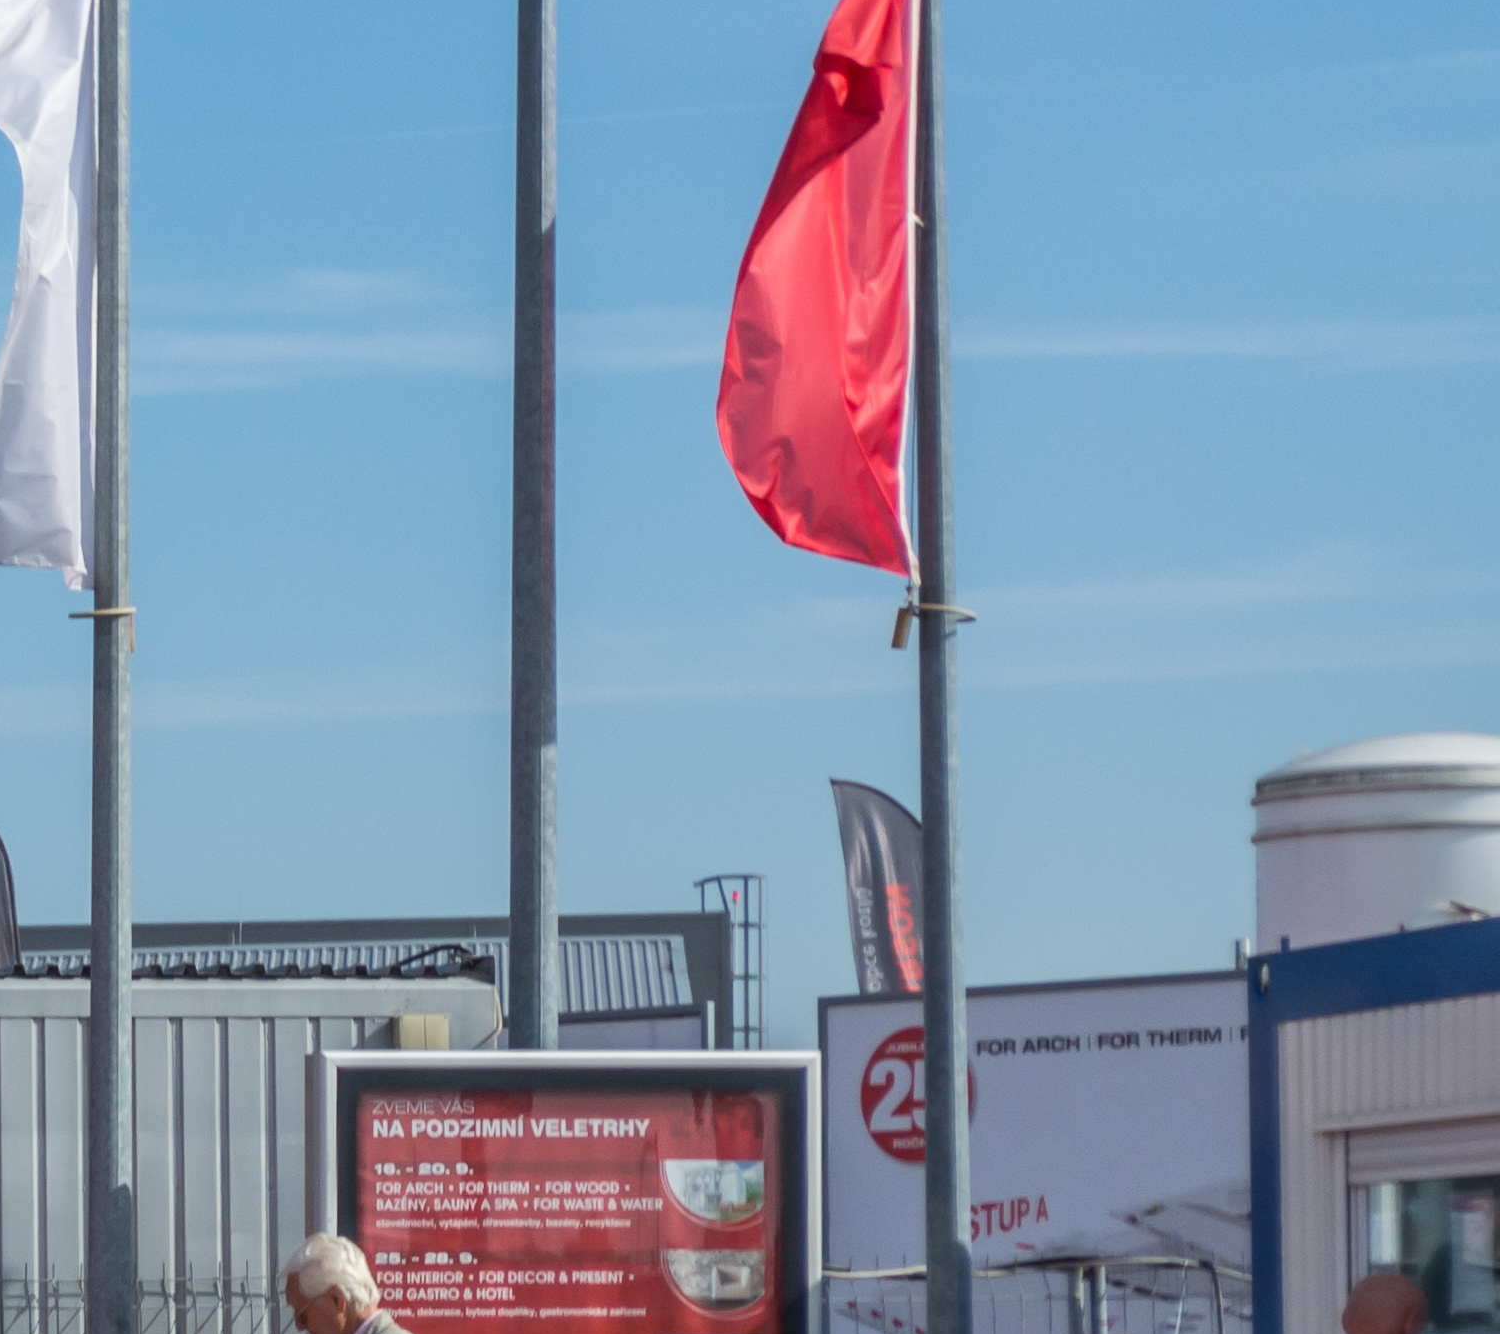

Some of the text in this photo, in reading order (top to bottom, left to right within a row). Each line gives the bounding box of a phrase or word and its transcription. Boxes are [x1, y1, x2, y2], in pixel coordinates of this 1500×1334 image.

[976, 1027, 1222, 1057] FOR ARCH FOR THERM
[373, 1114, 650, 1137] NA PODZIMNÍ VELETRHY
[376, 1181, 620, 1195] FOR ARCH FOR THERM FOR WOOD
